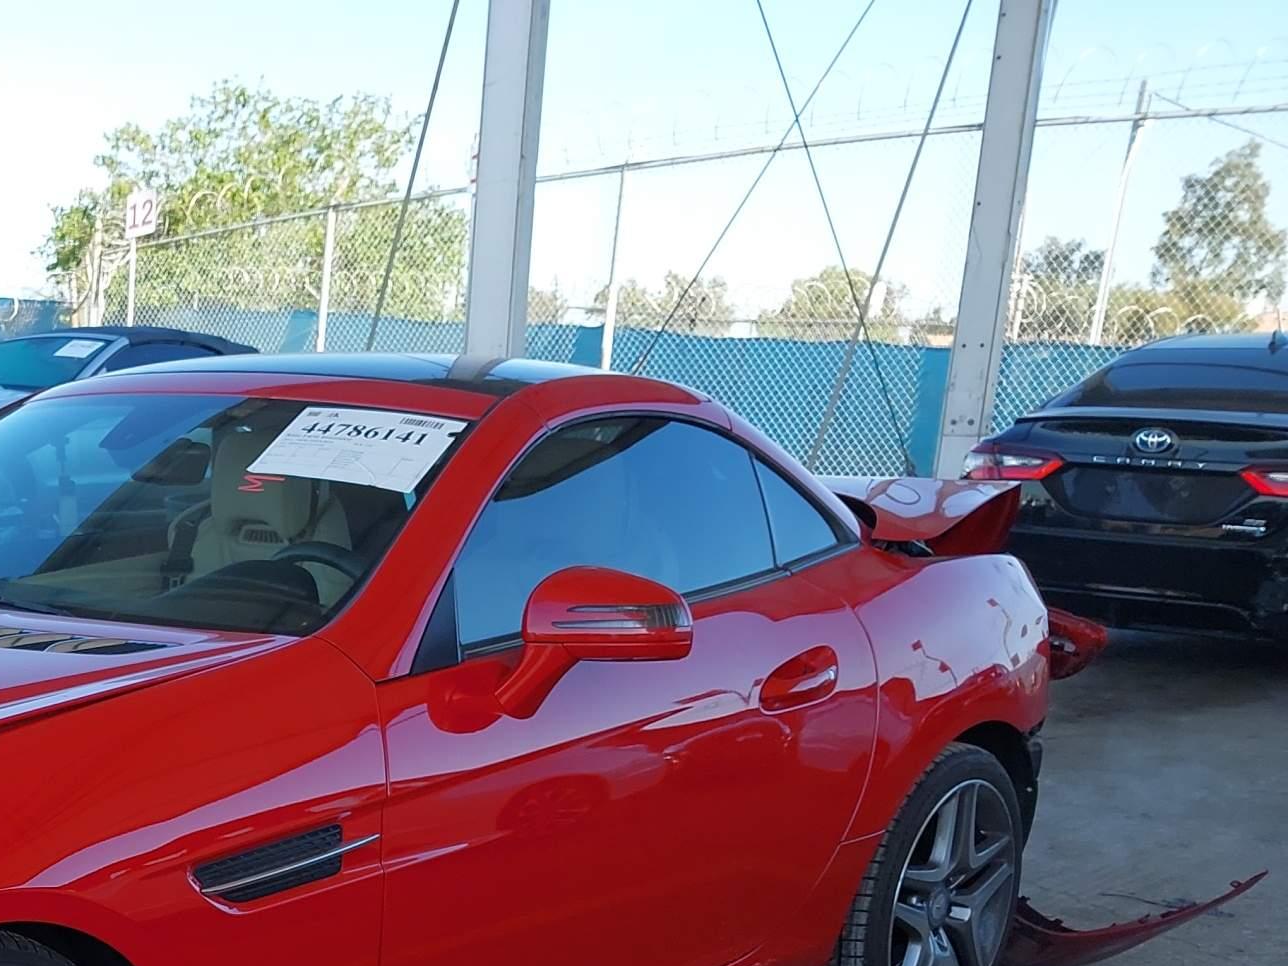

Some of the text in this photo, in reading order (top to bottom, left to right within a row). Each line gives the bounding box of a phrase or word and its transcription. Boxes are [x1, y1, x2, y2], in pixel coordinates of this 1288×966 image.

[128, 199, 154, 230] 12
[301, 421, 428, 446] 44786141
[1093, 455, 1205, 468] CAMRY
